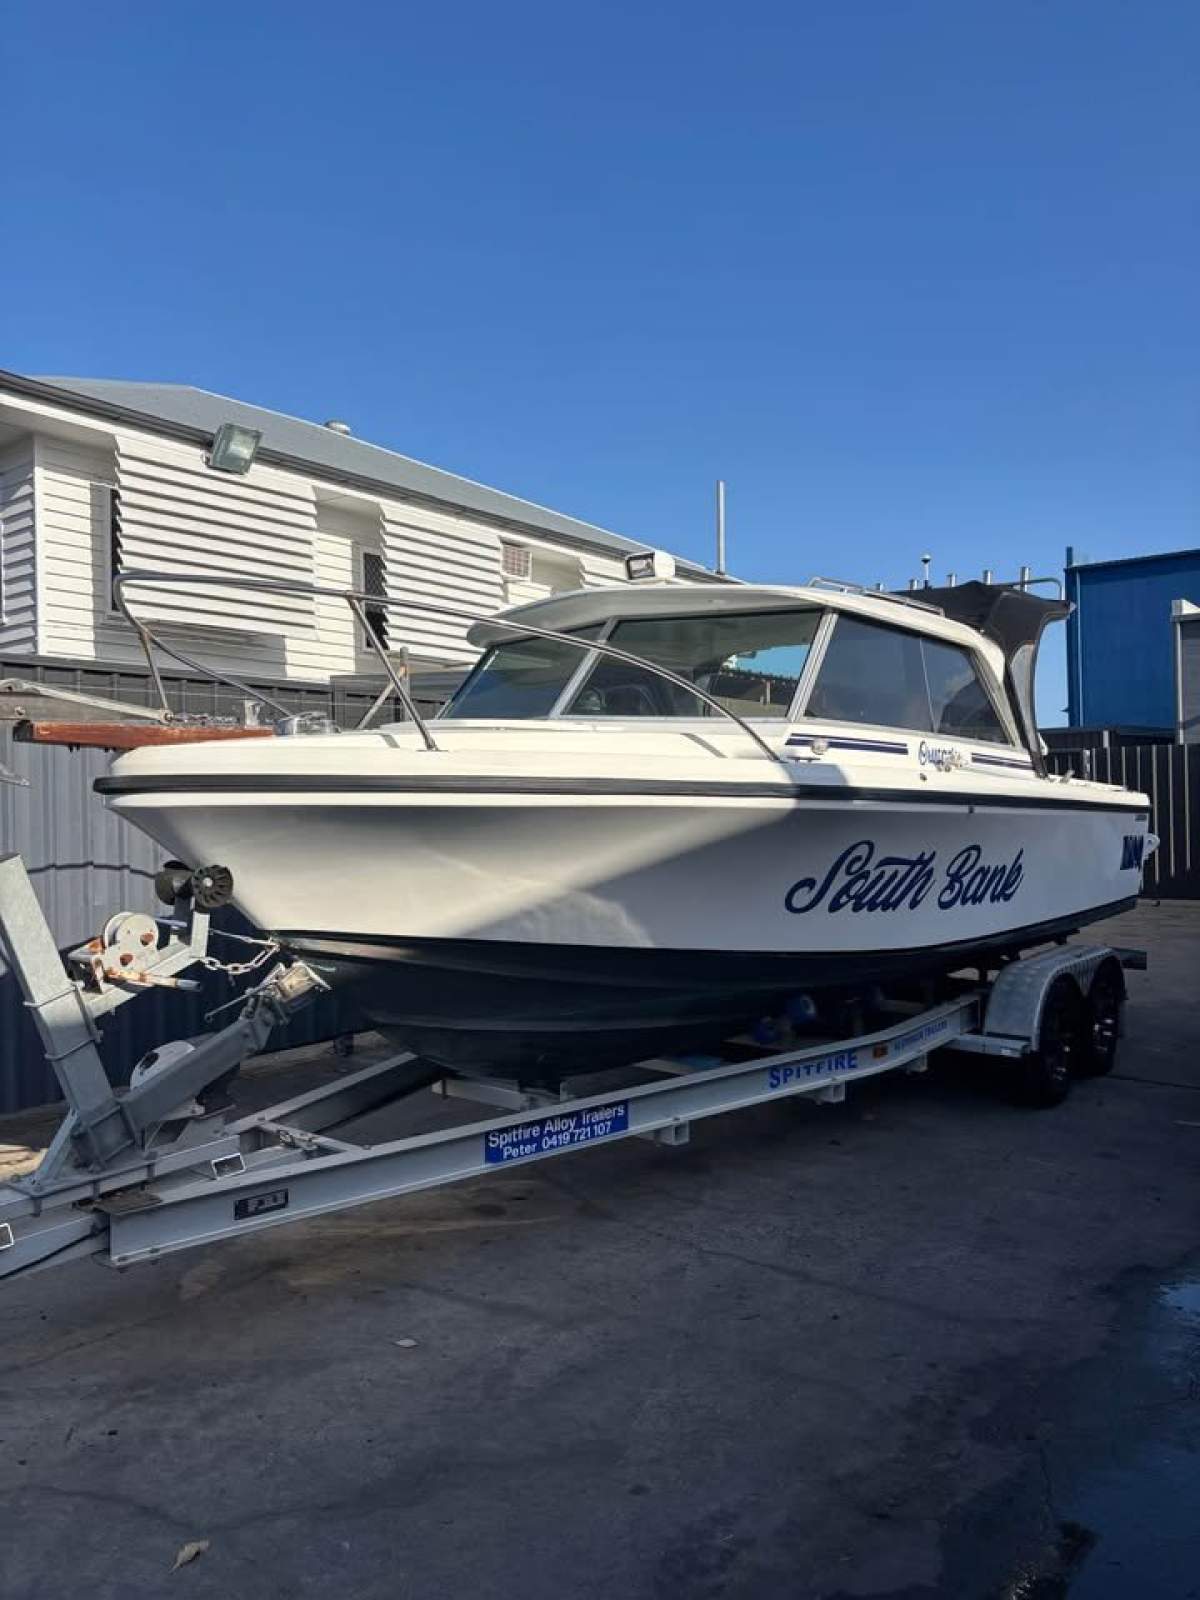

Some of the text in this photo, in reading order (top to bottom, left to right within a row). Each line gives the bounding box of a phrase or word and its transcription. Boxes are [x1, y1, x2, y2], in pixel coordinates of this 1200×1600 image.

[785, 840, 1024, 913] South Bank
[769, 1052, 858, 1089] SPITFIRE
[488, 1105, 625, 1148] Spitfire Alloy Trailers
[503, 1121, 612, 1160] Peter 0419 721 107
